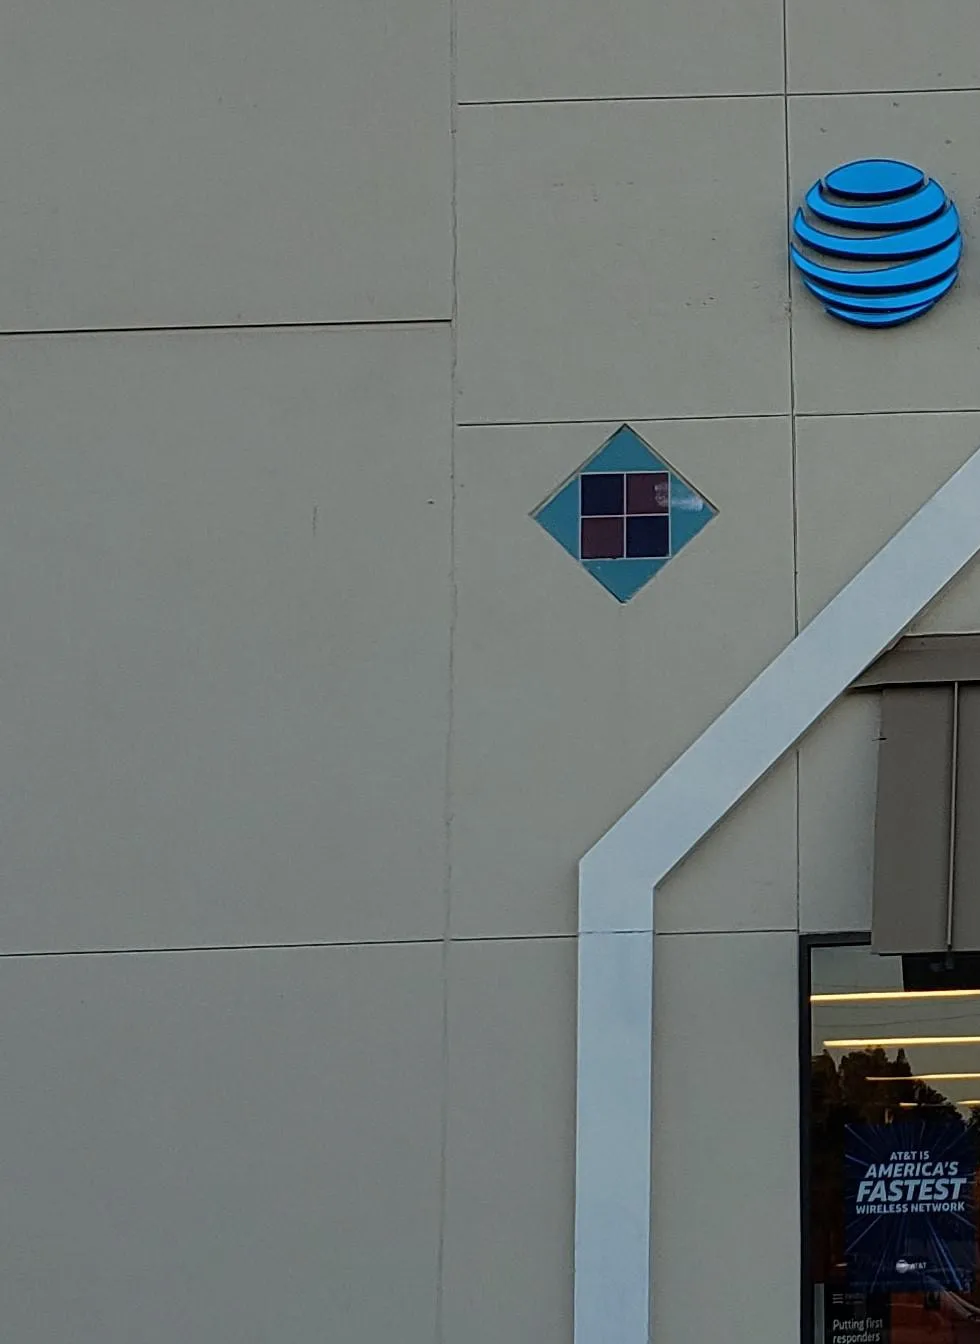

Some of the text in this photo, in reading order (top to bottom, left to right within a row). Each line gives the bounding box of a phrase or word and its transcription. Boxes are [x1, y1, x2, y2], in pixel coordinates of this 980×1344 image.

[890, 1150, 930, 1161] AT&T IS
[864, 1161, 960, 1178] AMERICA'S
[856, 1178, 968, 1203] FASTEST
[856, 1201, 965, 1214] WIRELESS NETWORK
[833, 1317, 883, 1331] Putting first
[833, 1331, 880, 1344] responders
